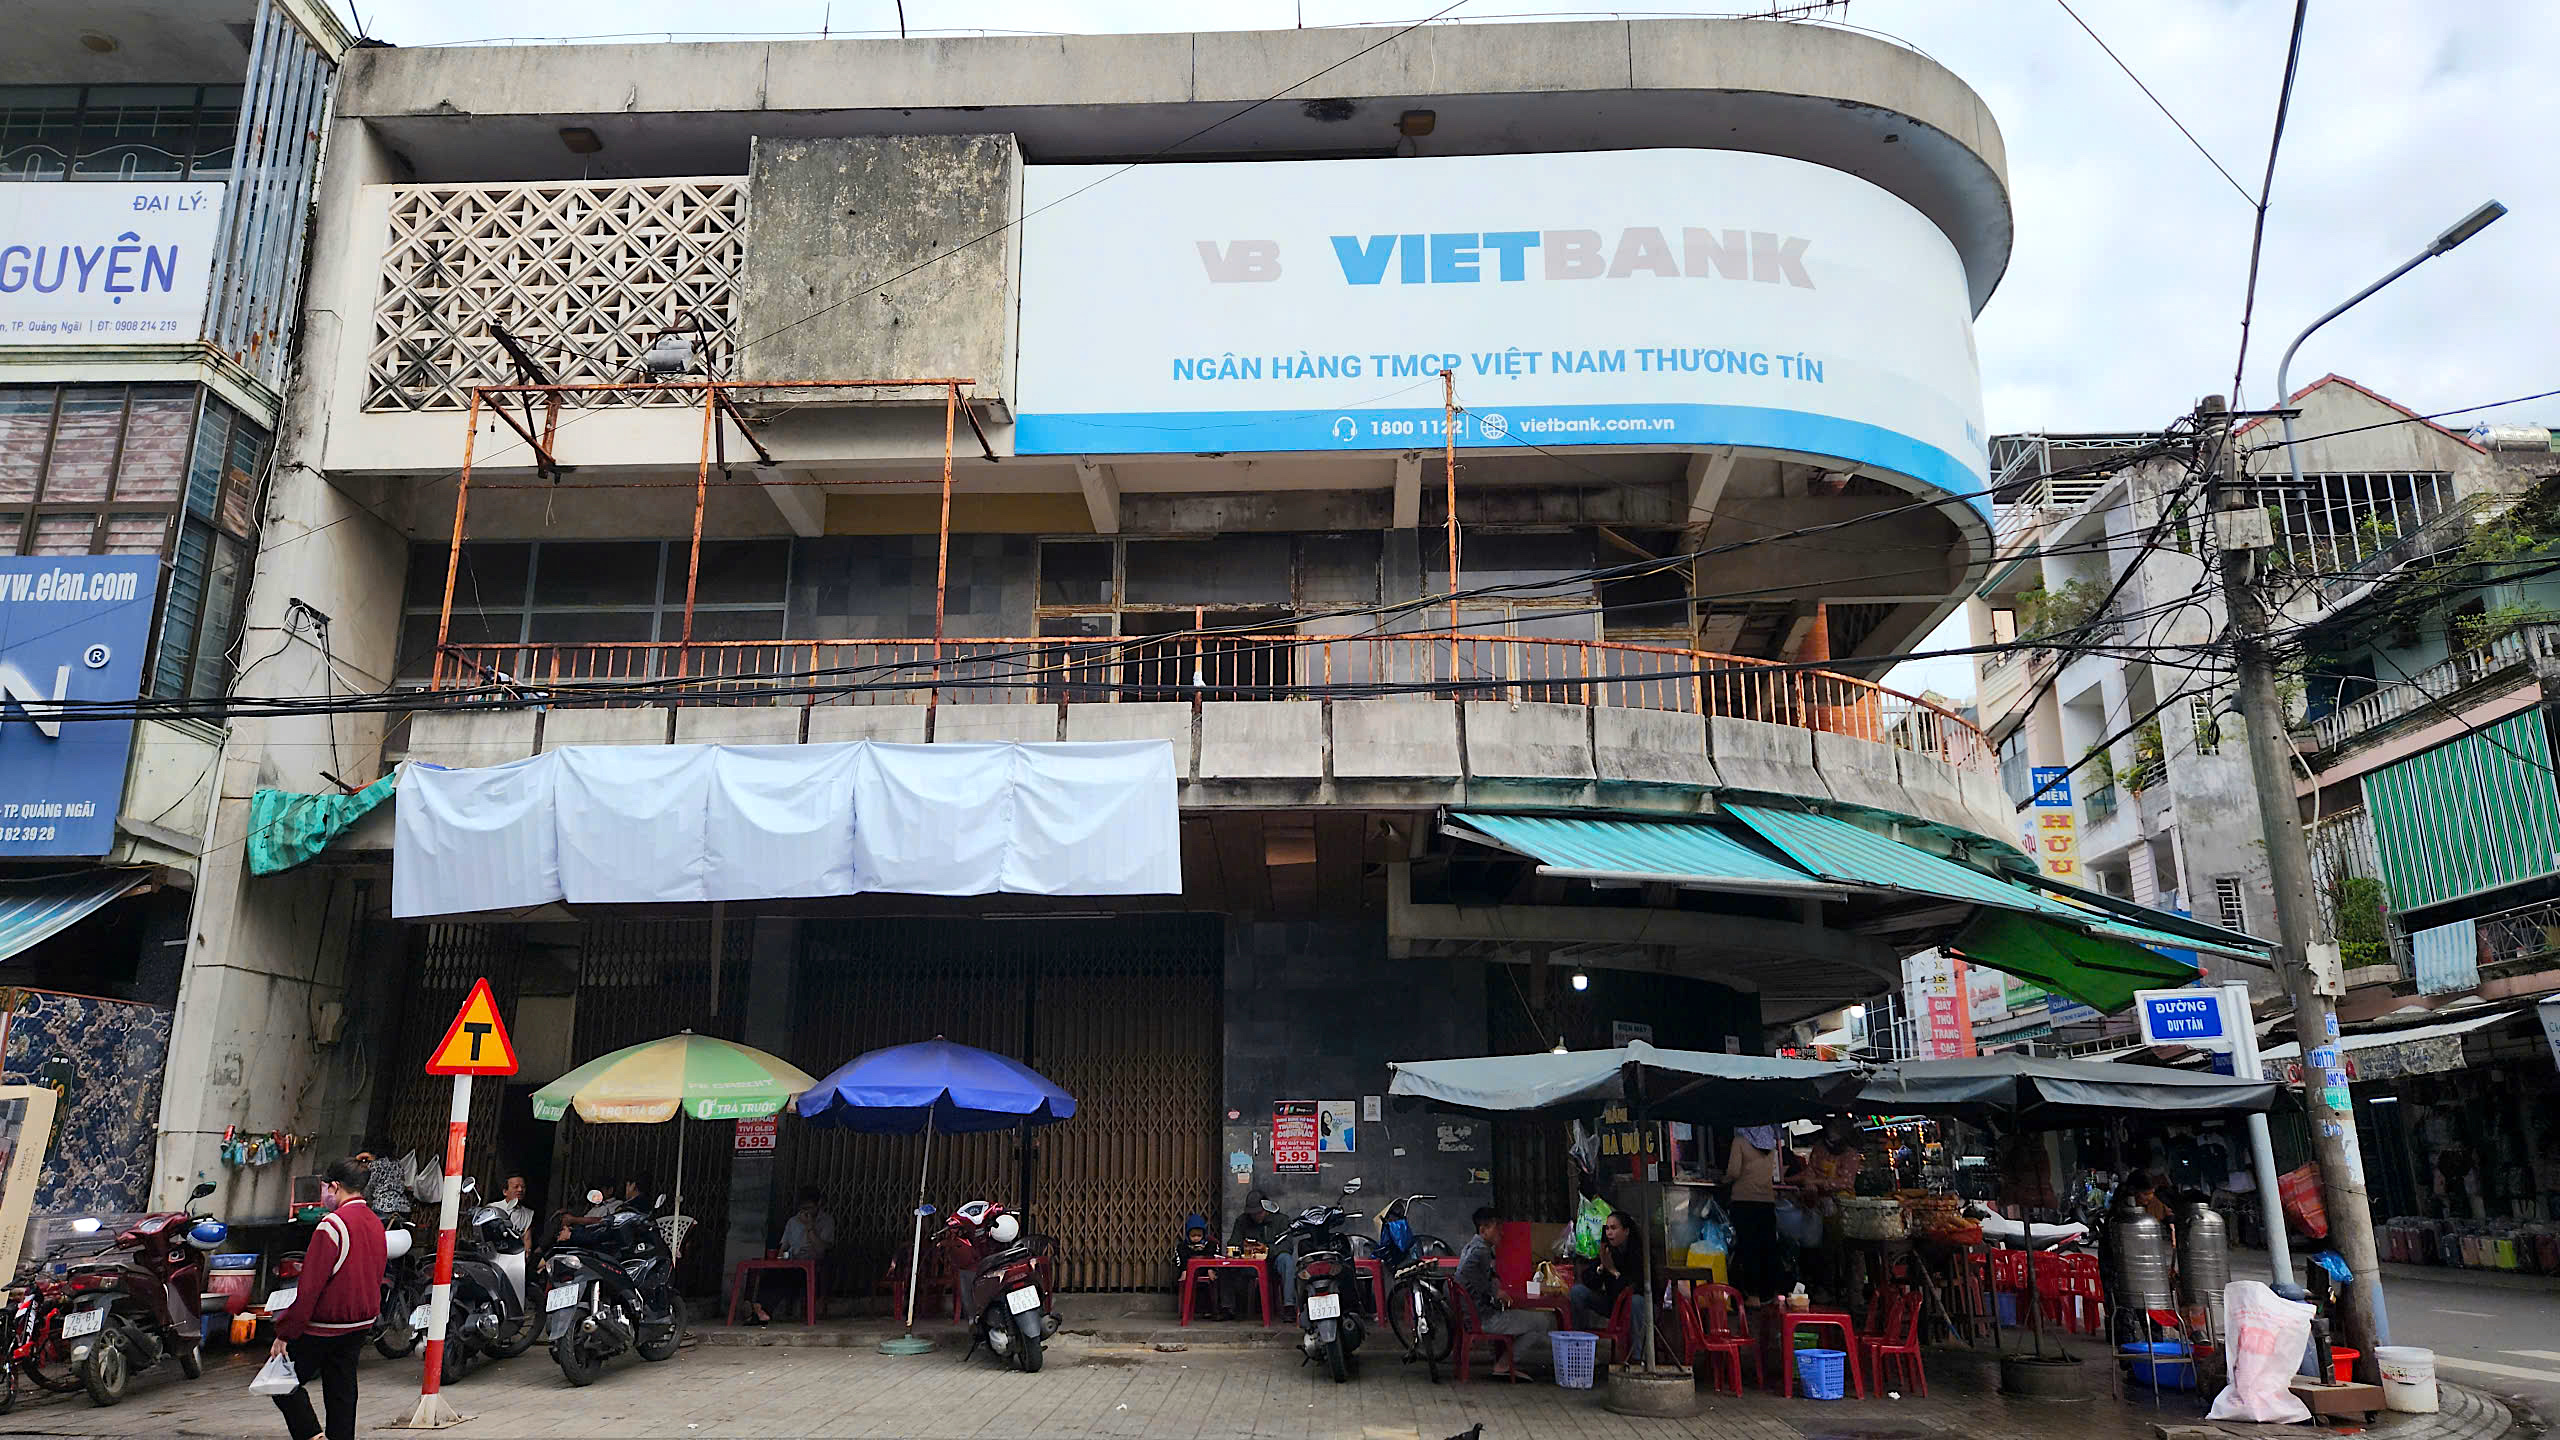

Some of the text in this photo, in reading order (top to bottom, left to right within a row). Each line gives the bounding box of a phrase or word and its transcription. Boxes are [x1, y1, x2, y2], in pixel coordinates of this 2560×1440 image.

[132, 190, 208, 213] ĐẠI LÝ:
[1196, 226, 1816, 290] VB VIETBANK
[12, 321, 25, 332] TP.
[28, 318, 57, 334] Quảng
[61, 319, 82, 334] Ngãi
[97, 320, 113, 332] ĐT:
[115, 320, 138, 332] 0908
[140, 320, 157, 332] 214
[159, 320, 177, 332] 219
[1173, 346, 1824, 384] NGÂN HÀNG TMCP VIỆT NAM THƯƠNG TÍN
[1370, 420, 1413, 436] 1800
[1520, 417, 1675, 433] vietbank.com.vn
[4, 799, 96, 818] TP. QUẢNG NGÃI
[22, 827, 37, 841] 39
[2155, 999, 2207, 1014] ĐƯỜNG
[2167, 1017, 2204, 1033] DUY TÂN
[1934, 1029, 1960, 1040] TRANG
[737, 1136, 769, 1148] 6.99
[1278, 1151, 1309, 1163] 5.99
